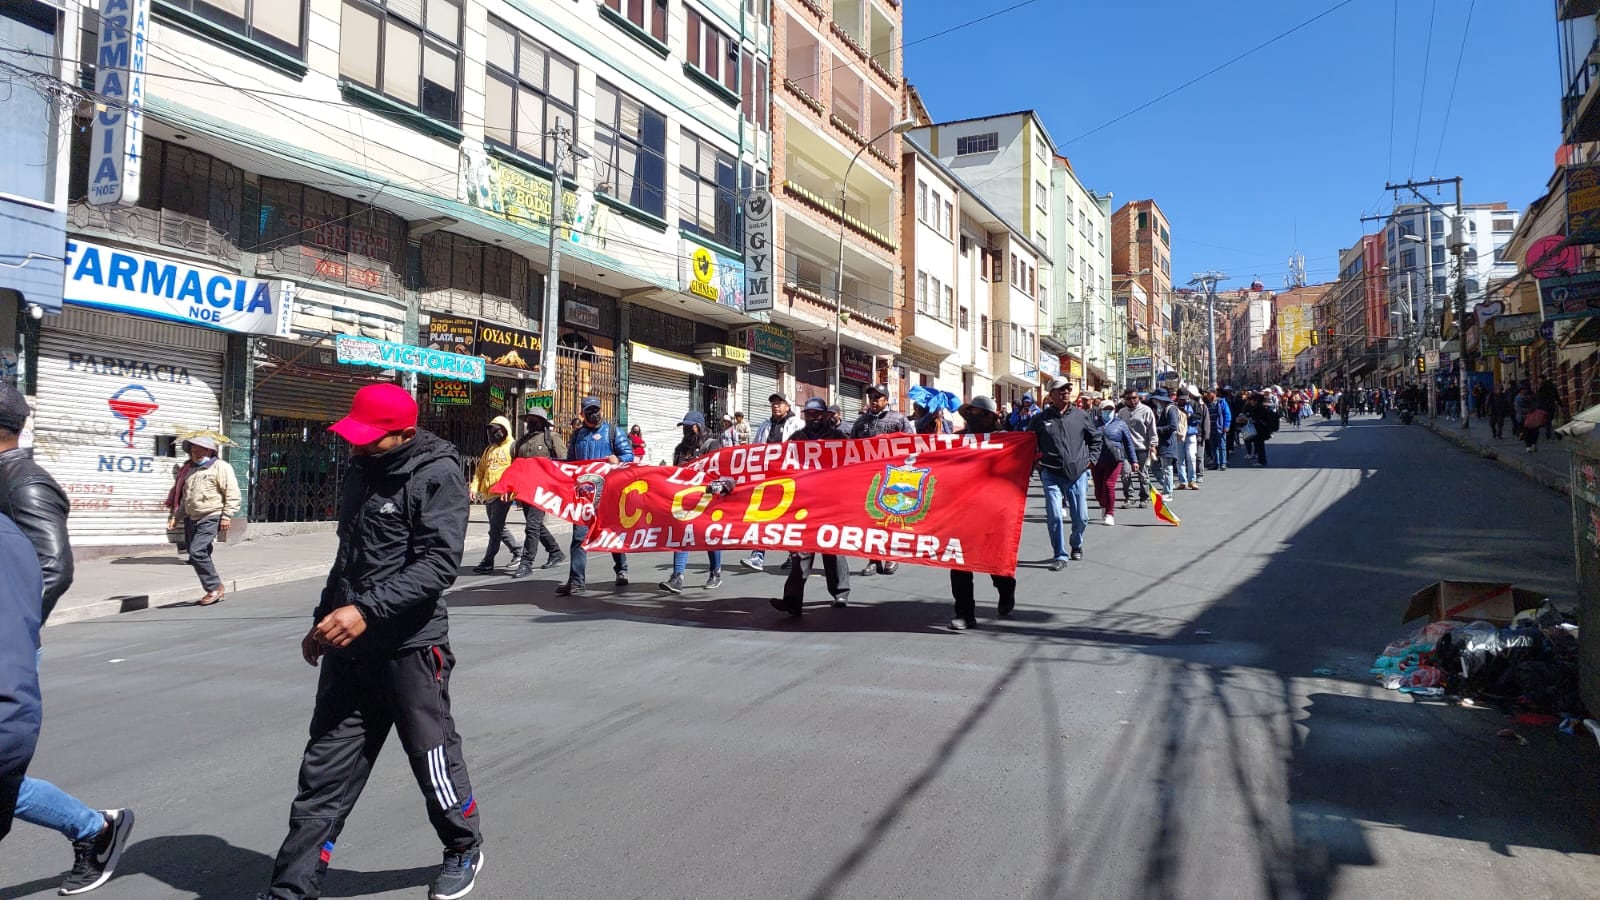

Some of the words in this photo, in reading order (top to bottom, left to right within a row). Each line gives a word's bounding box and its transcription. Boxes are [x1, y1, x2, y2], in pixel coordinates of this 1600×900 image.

[748, 232, 768, 296] GYM
[65, 242, 272, 314] FARMACIA
[189, 306, 220, 323] NOE
[430, 322, 448, 334] ORO
[430, 332, 454, 343] PLATA
[478, 325, 511, 345] JOYAS
[513, 331, 528, 349] LA
[67, 352, 192, 385] FARMACIA
[379, 345, 474, 375] VICTORIA
[433, 390, 468, 398] PLATA
[434, 380, 463, 390] ORO
[97, 455, 154, 473] NOE
[730, 433, 1003, 476] DEPARTAMENTAL
[630, 527, 662, 549] DE
[666, 524, 696, 547] LA
[704, 523, 806, 546] CLASE
[816, 524, 965, 565] OBRERA
